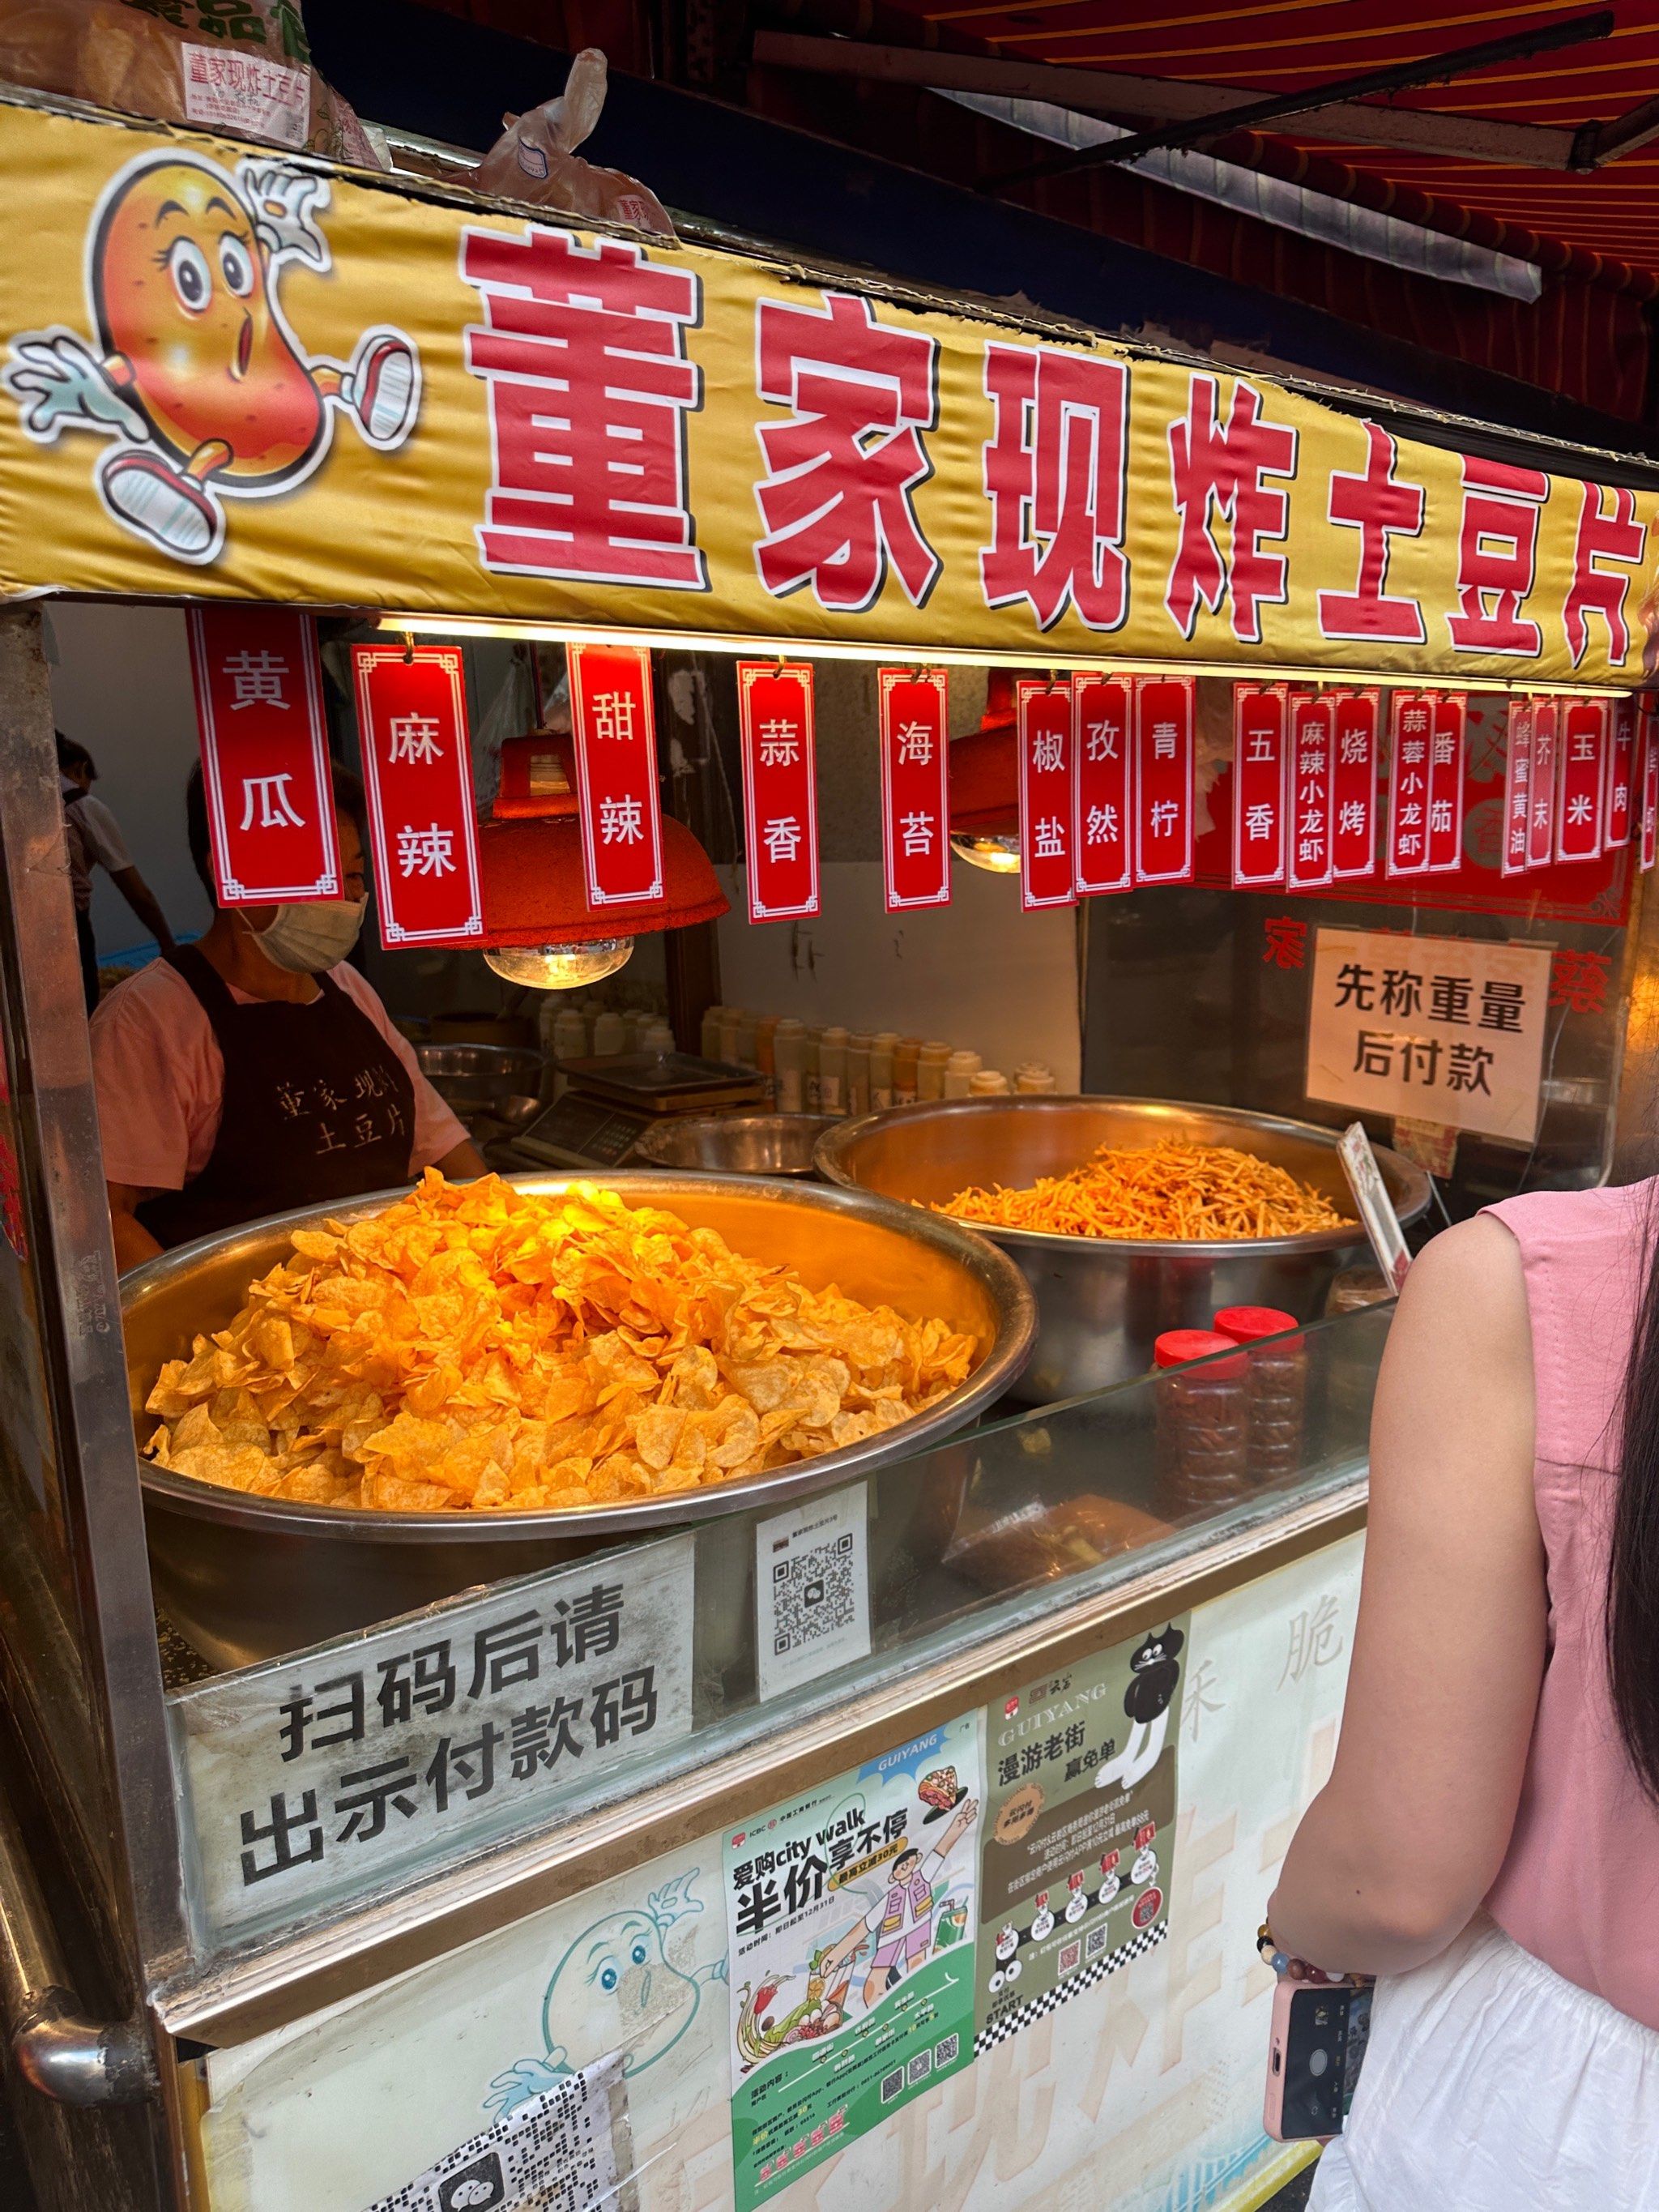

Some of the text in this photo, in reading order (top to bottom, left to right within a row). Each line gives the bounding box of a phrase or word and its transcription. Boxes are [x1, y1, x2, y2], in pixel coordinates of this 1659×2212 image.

[458, 223, 1648, 669] 董家现炸土豆片
[223, 650, 305, 831] 黄瓜
[592, 691, 645, 845] 甜辣
[759, 719, 802, 863] 蒜香
[897, 720, 935, 856] 海苔
[1086, 720, 1120, 845] 孜然
[1150, 722, 1179, 838] 青柠
[1245, 729, 1276, 841] 五香
[1339, 728, 1368, 836] 烧烤
[1397, 709, 1427, 856] 蒜蓉小龙虾
[1431, 731, 1456, 833] 番茄
[1533, 734, 1552, 830] 芥末
[1567, 733, 1596, 826] 玉米
[1614, 720, 1631, 813] 牛肉
[389, 712, 457, 878] 麻辣
[1032, 729, 1066, 859] 椒盐
[1299, 721, 1326, 863] 麻辣小龙虾
[1334, 963, 1527, 1034] 先称重量
[1354, 1029, 1495, 1096] 后付款
[315, 1103, 405, 1155] 土豆片
[279, 1582, 625, 1762] 扫码后请
[998, 1683, 1108, 1747] GUIYANG
[240, 1664, 658, 1887] 出示付款码
[878, 1734, 937, 1771] GUIYANG
[998, 1720, 1086, 1787] 漫游老街
[1064, 1738, 1116, 1783] 赢免单
[749, 1825, 766, 1838] ICBC
[780, 1800, 817, 1822] 中国工商银行
[815, 1807, 866, 1847] walk
[838, 1843, 899, 1885] 最高立减30元
[986, 1994, 1024, 2025] START
